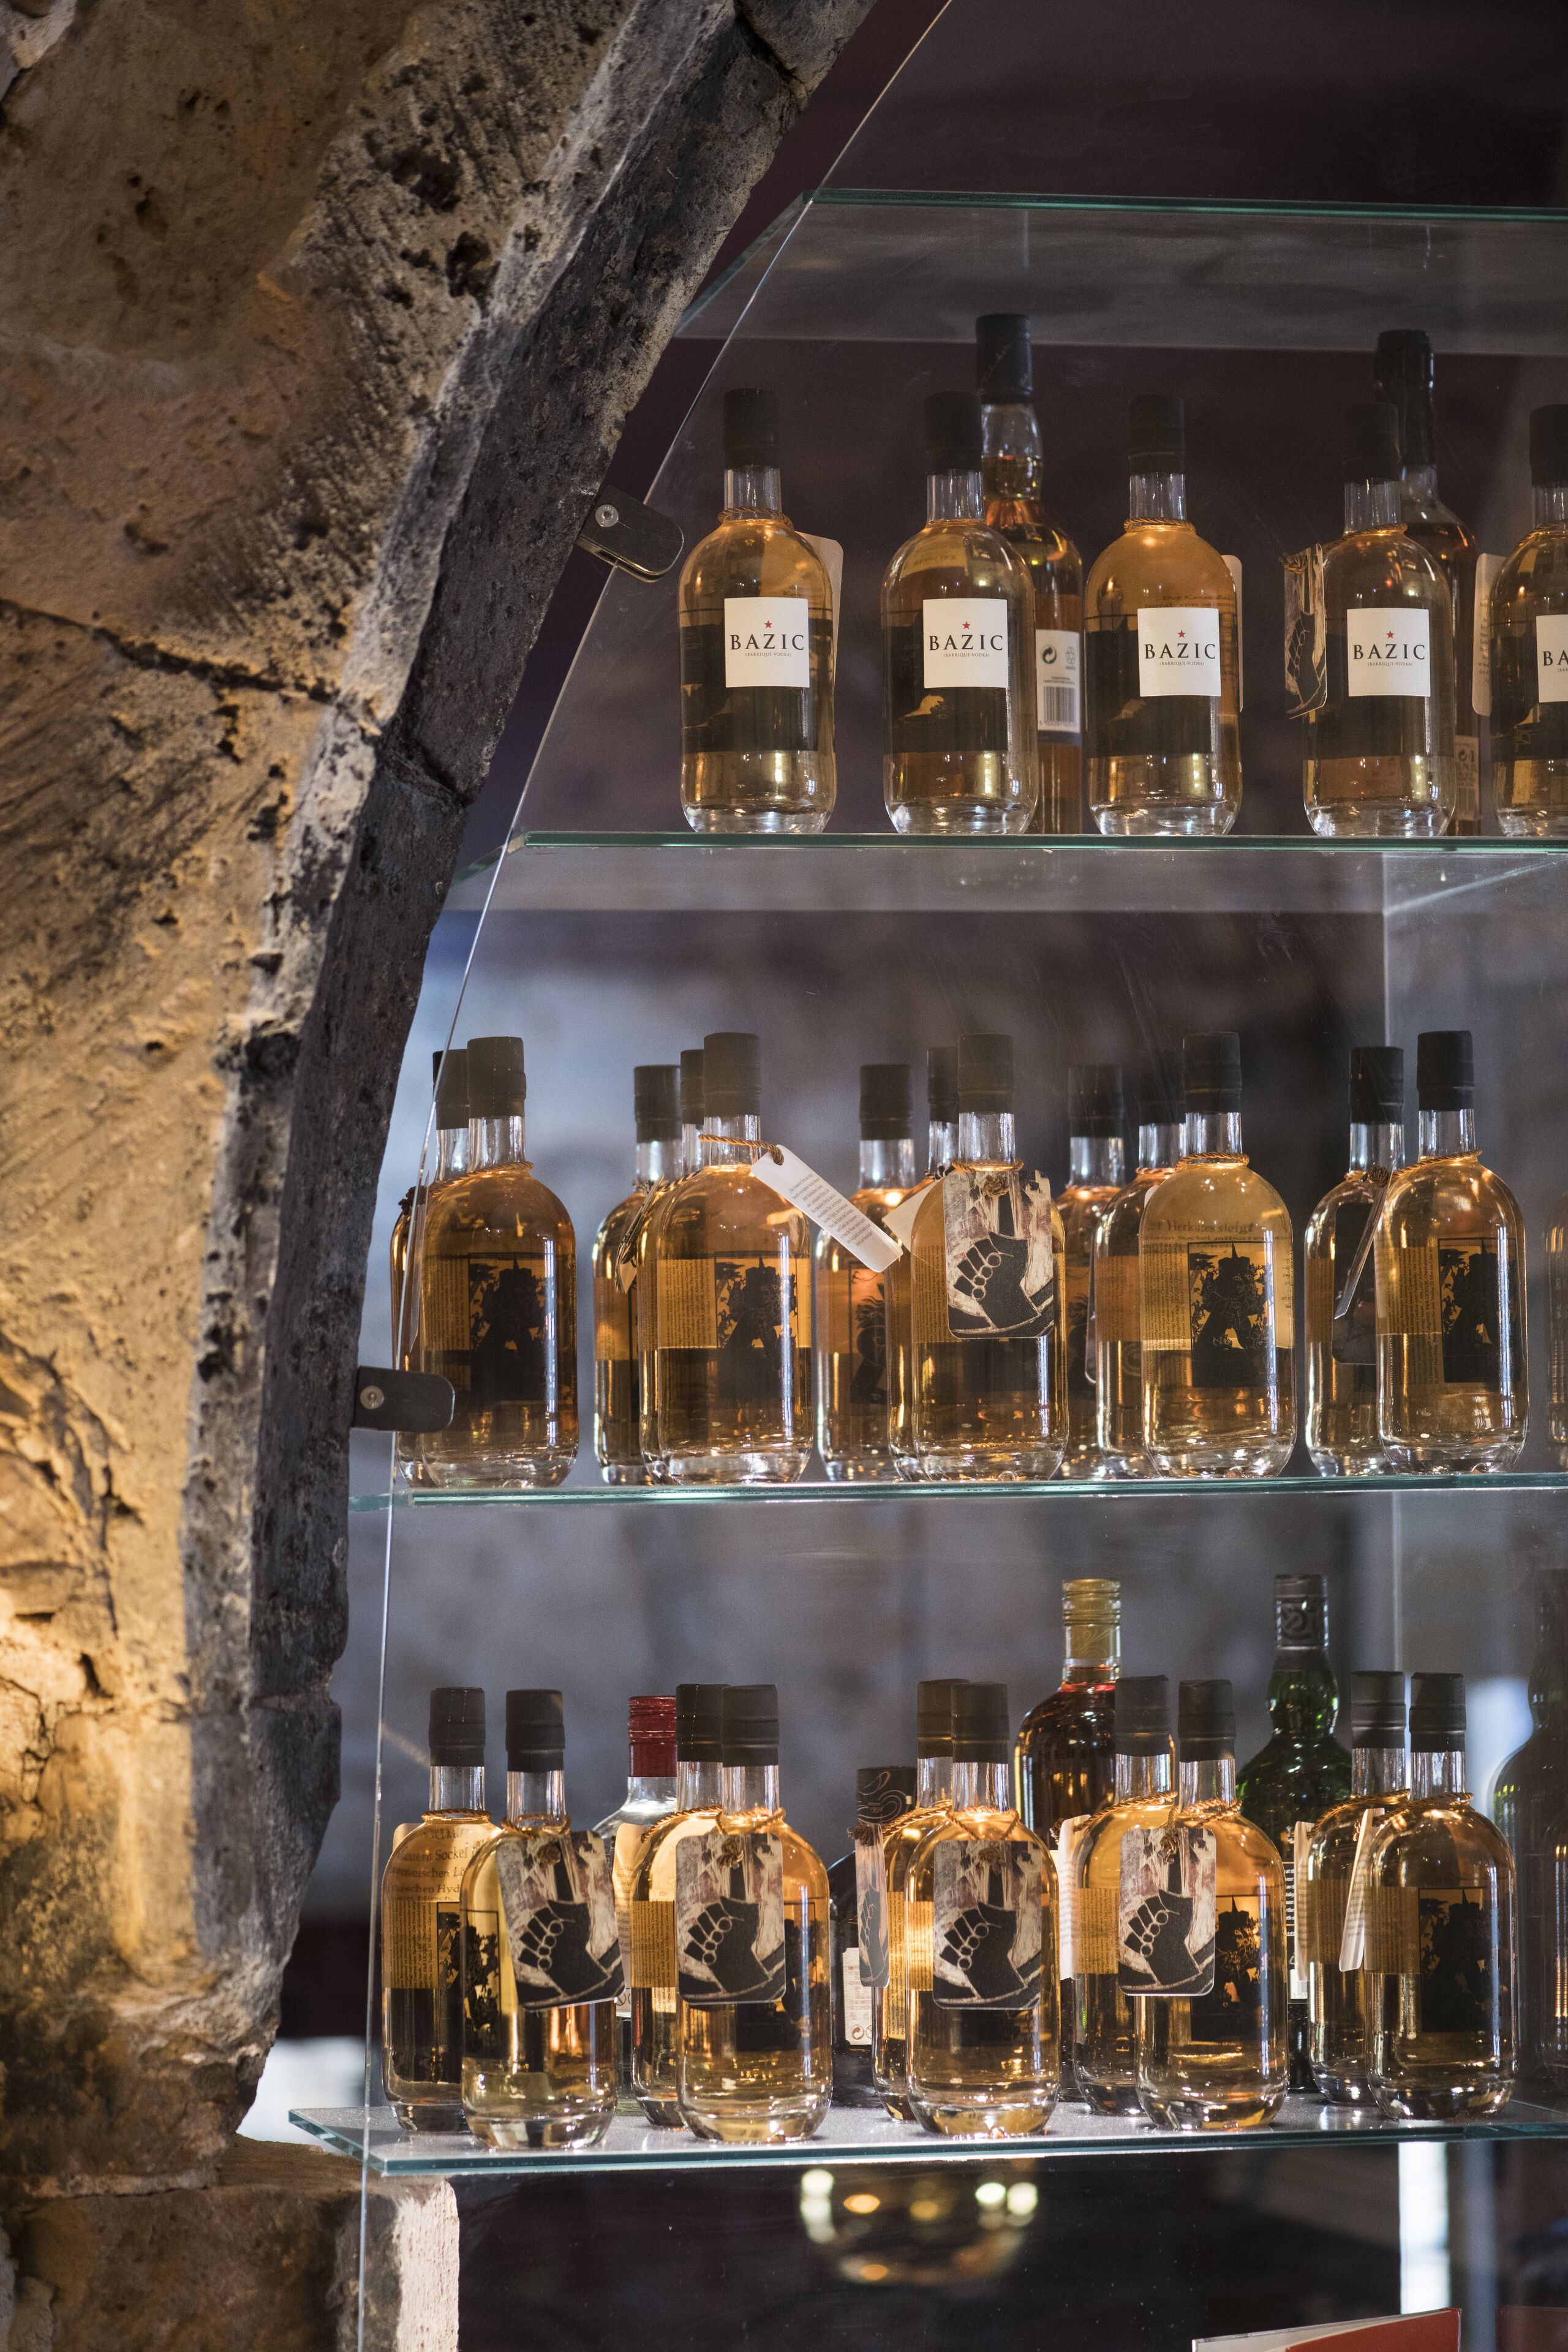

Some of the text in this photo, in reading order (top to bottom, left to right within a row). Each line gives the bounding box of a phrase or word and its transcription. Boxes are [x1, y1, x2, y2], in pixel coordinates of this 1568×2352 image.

[730, 633, 804, 650] BAZIC
[929, 635, 1003, 651] BAZIC
[1144, 643, 1216, 660] BAZIC
[1352, 644, 1425, 660] BAZIC
